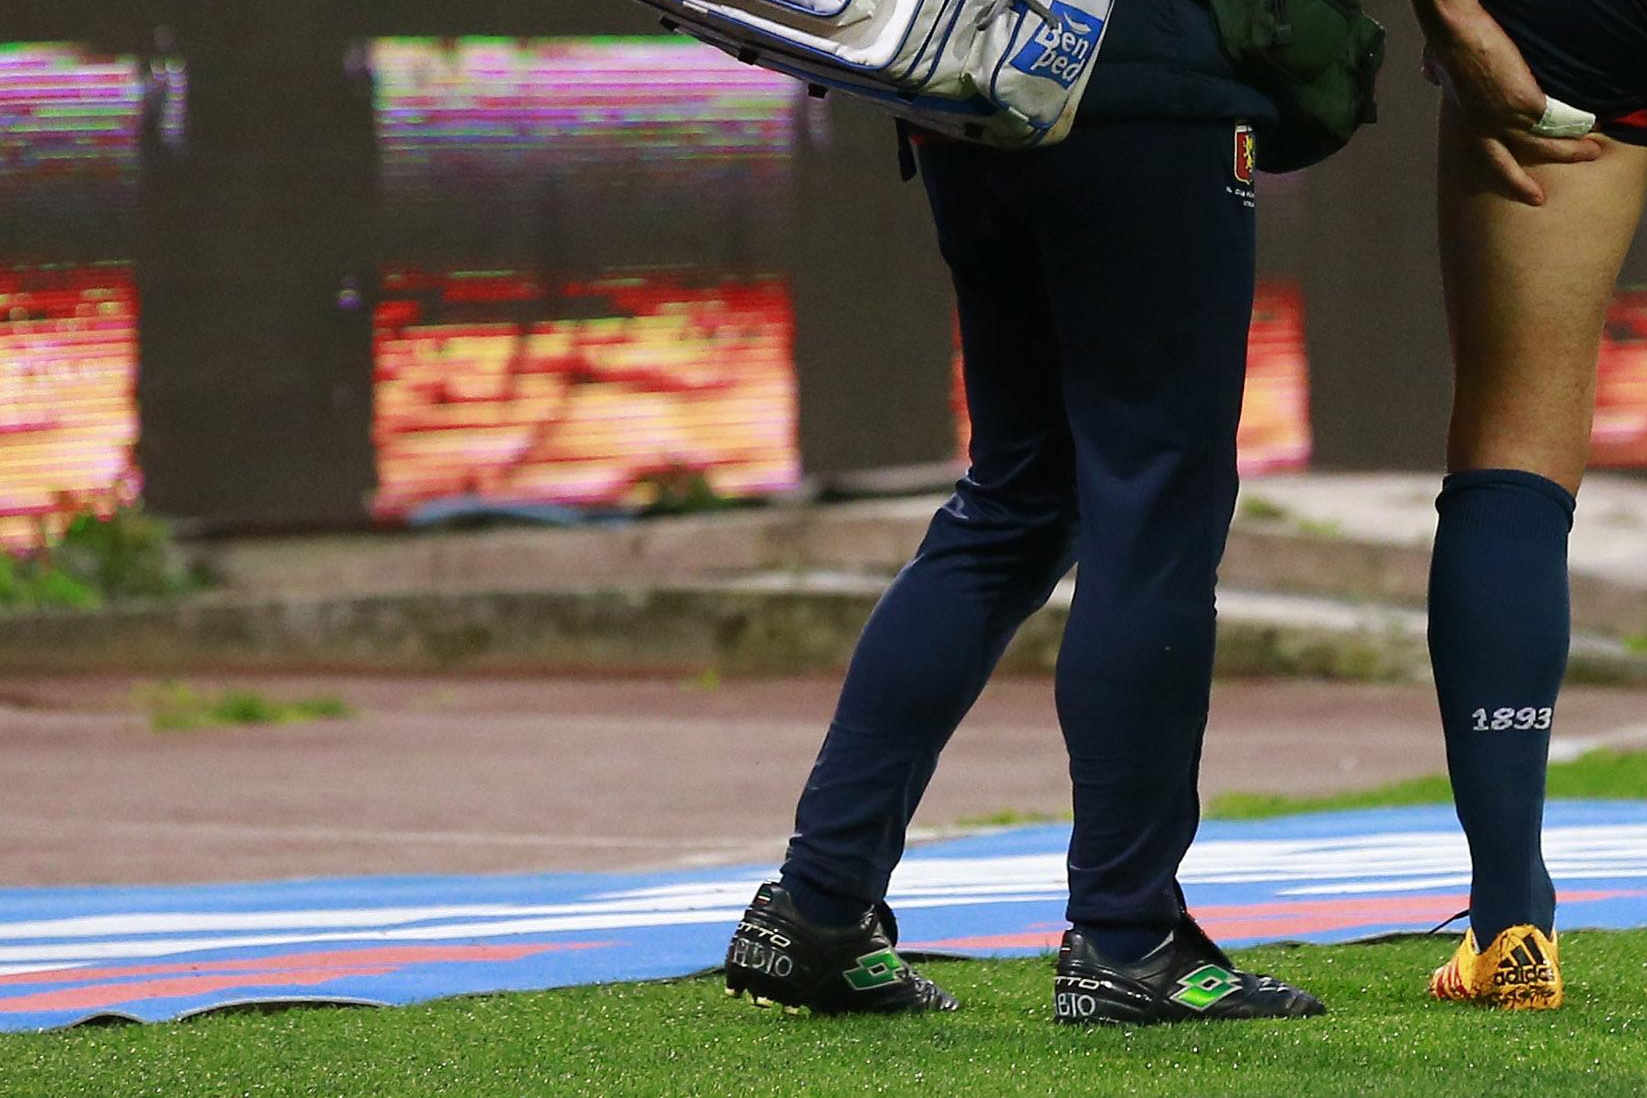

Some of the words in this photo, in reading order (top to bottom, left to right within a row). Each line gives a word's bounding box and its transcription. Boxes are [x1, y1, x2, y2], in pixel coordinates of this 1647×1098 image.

[1034, 21, 1090, 60] Ben
[1029, 49, 1086, 82] ped
[1471, 706, 1553, 731] 1893
